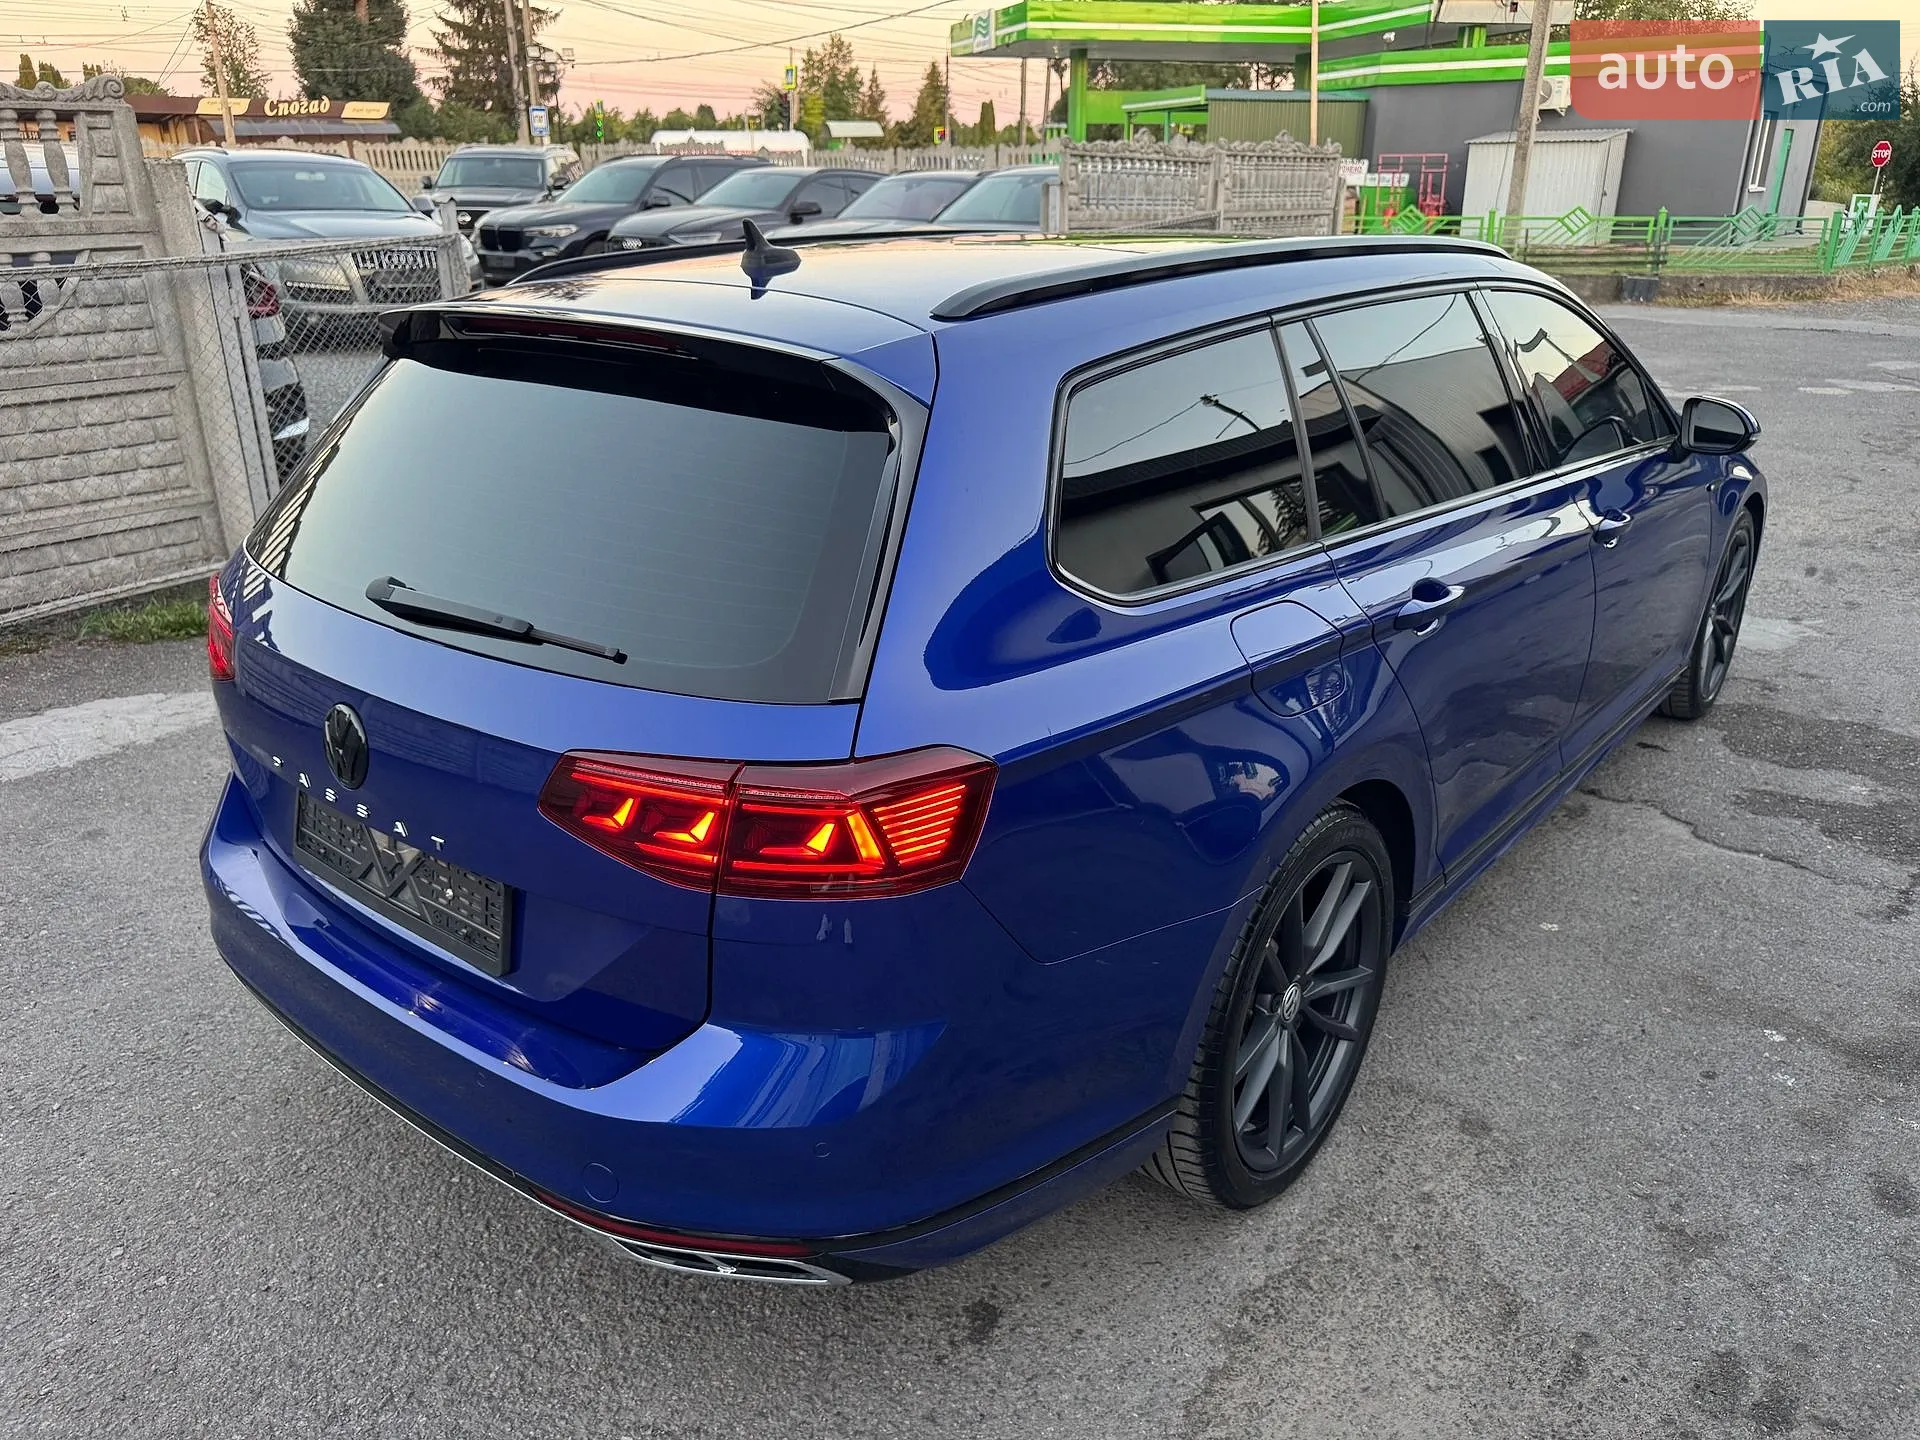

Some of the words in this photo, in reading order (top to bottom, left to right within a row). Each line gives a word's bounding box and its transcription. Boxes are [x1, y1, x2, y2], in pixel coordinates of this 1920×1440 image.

[263, 95, 331, 117] Спогад
[1873, 150, 1889, 159] STOP
[272, 755, 446, 852] PASSAT
